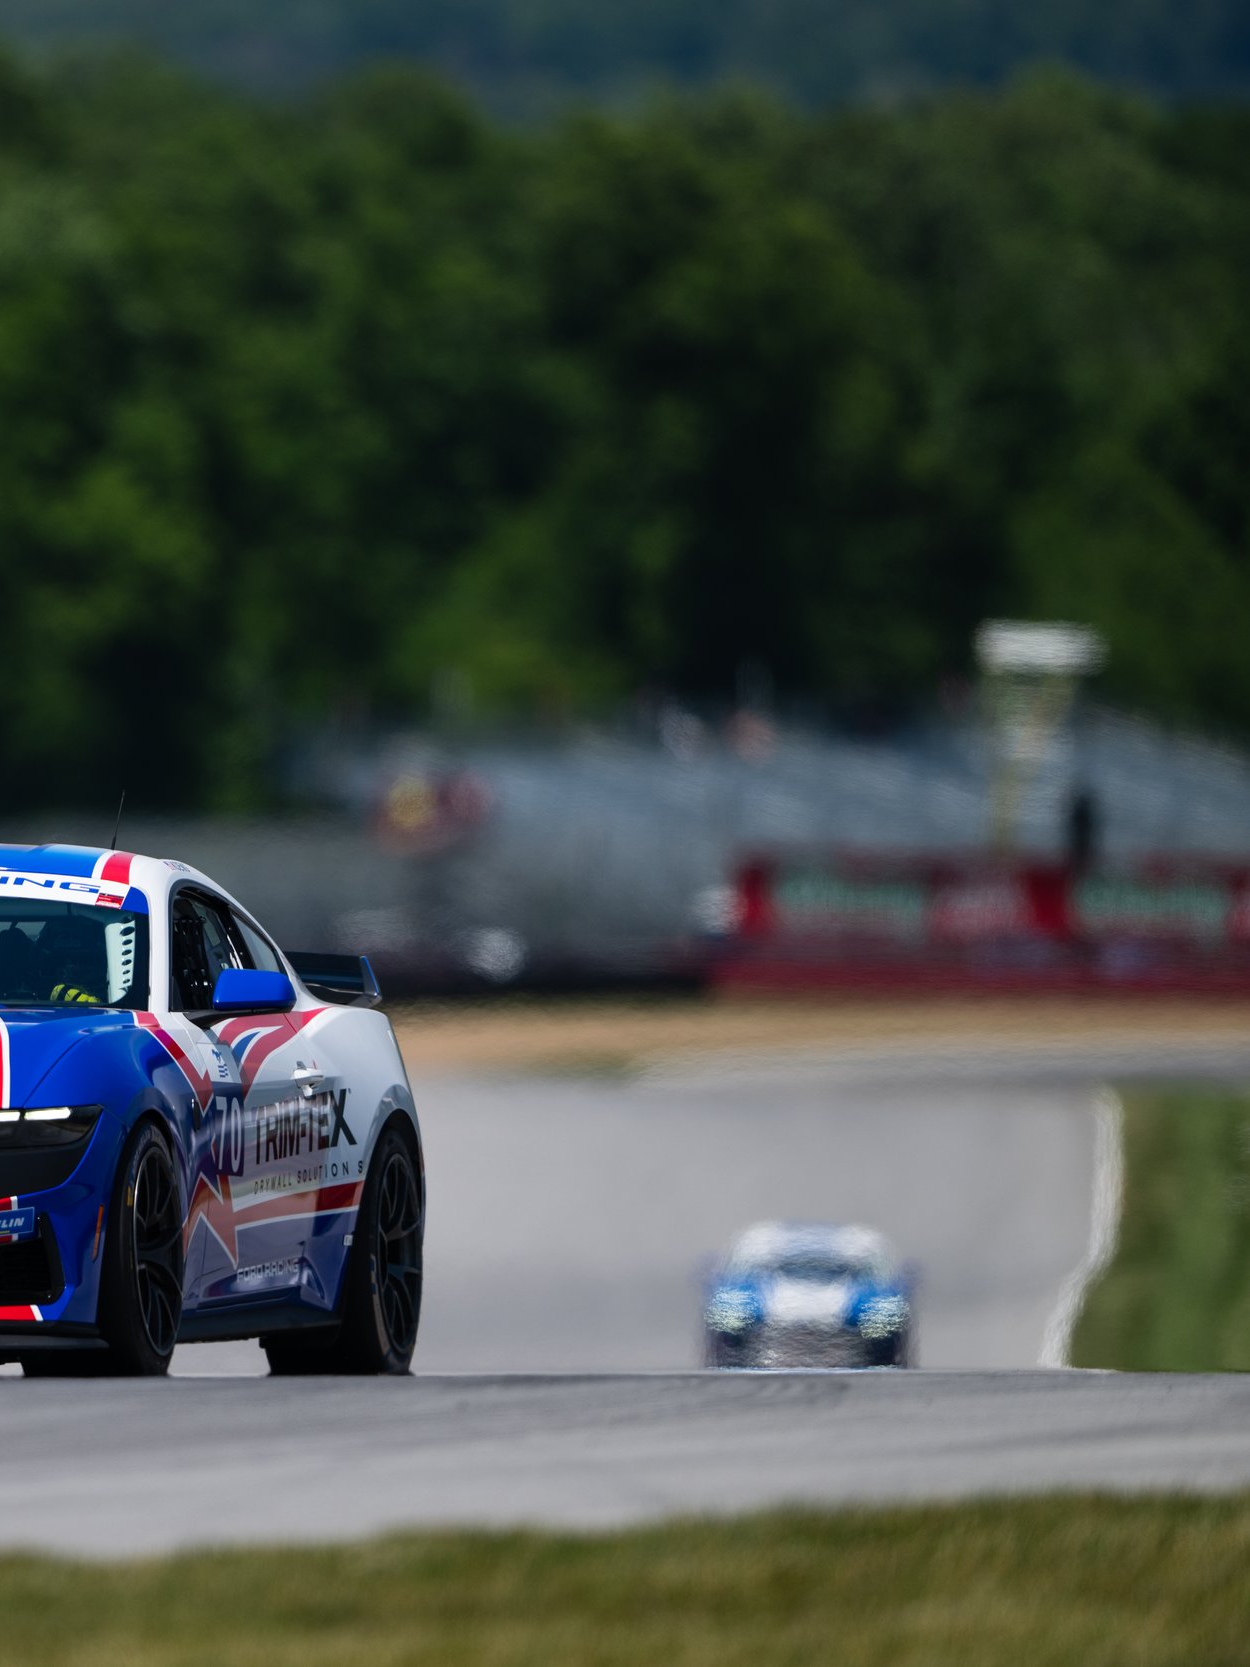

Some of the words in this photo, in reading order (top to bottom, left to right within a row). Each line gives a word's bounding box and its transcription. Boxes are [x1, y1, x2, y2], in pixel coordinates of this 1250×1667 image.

[216, 1096, 242, 1173] 70
[254, 1173, 292, 1195] DRYWALL
[237, 1264, 263, 1282] FORD
[264, 1258, 299, 1277] RACING
